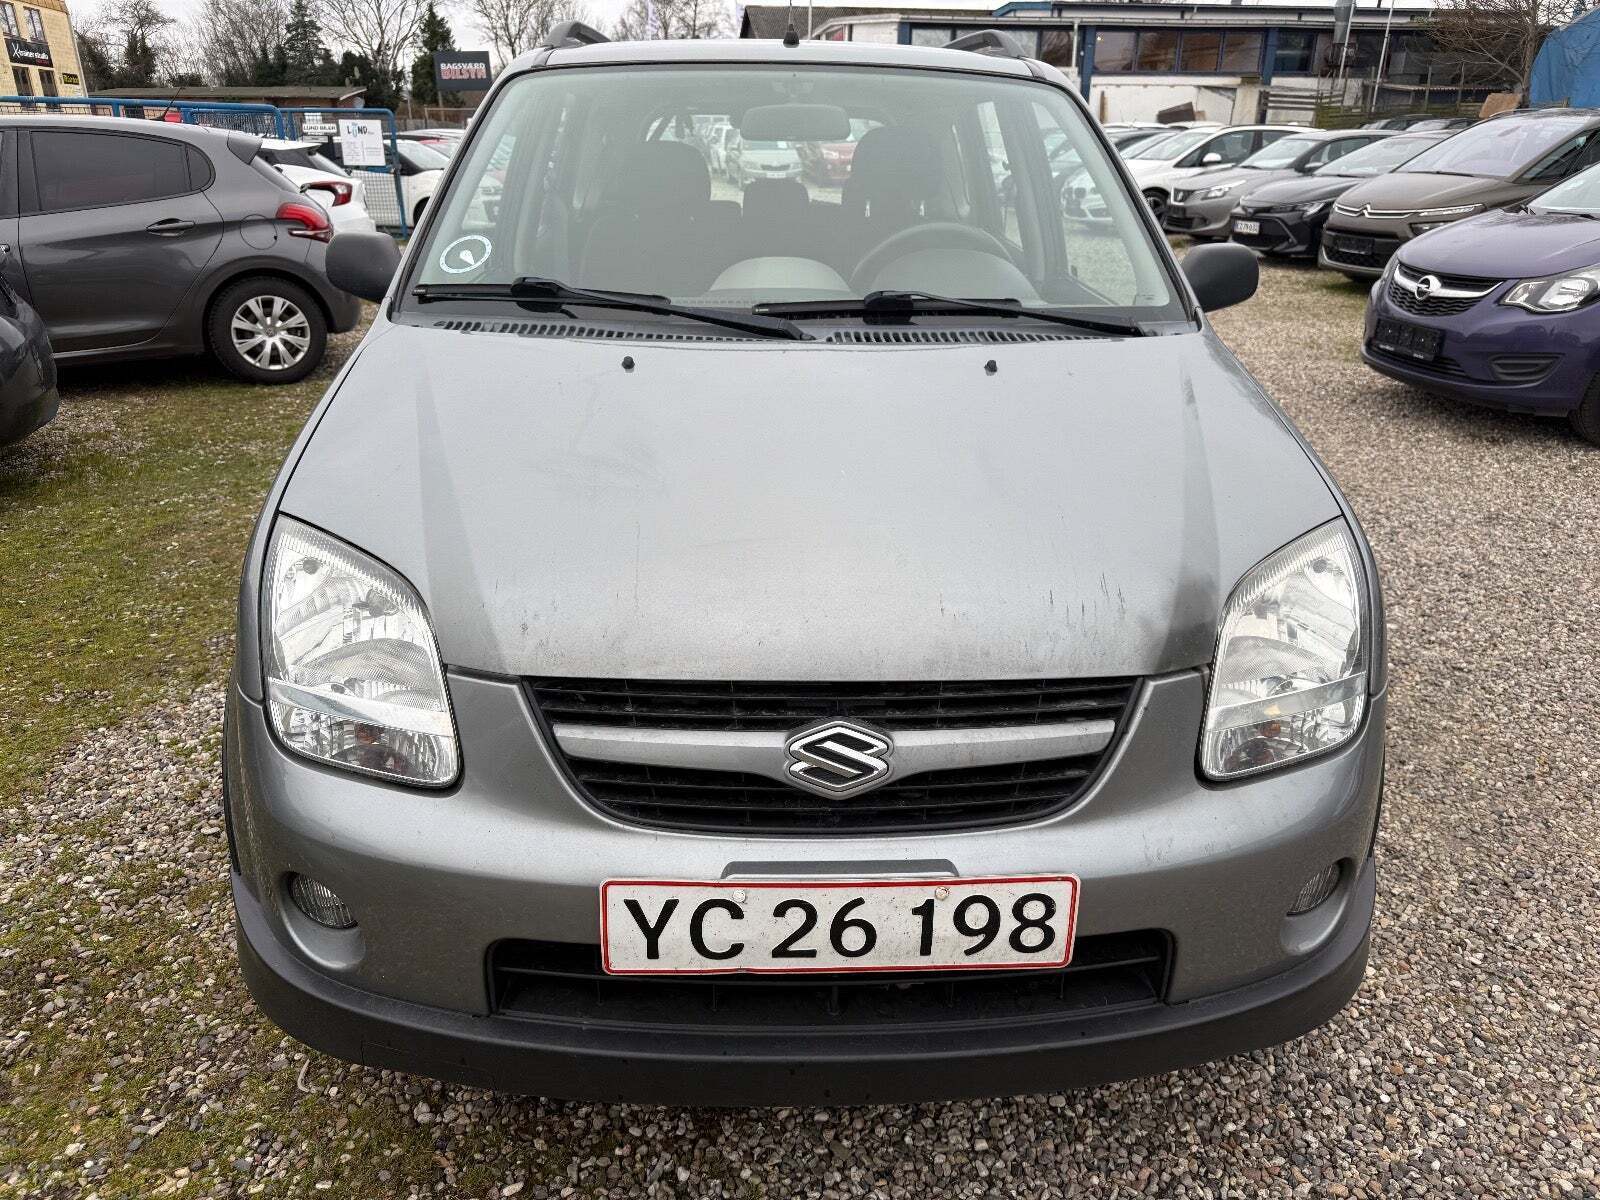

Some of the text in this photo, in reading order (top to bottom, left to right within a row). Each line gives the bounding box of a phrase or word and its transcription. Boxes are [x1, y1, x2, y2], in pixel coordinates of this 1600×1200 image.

[623, 893, 1057, 960] YC 26 198
